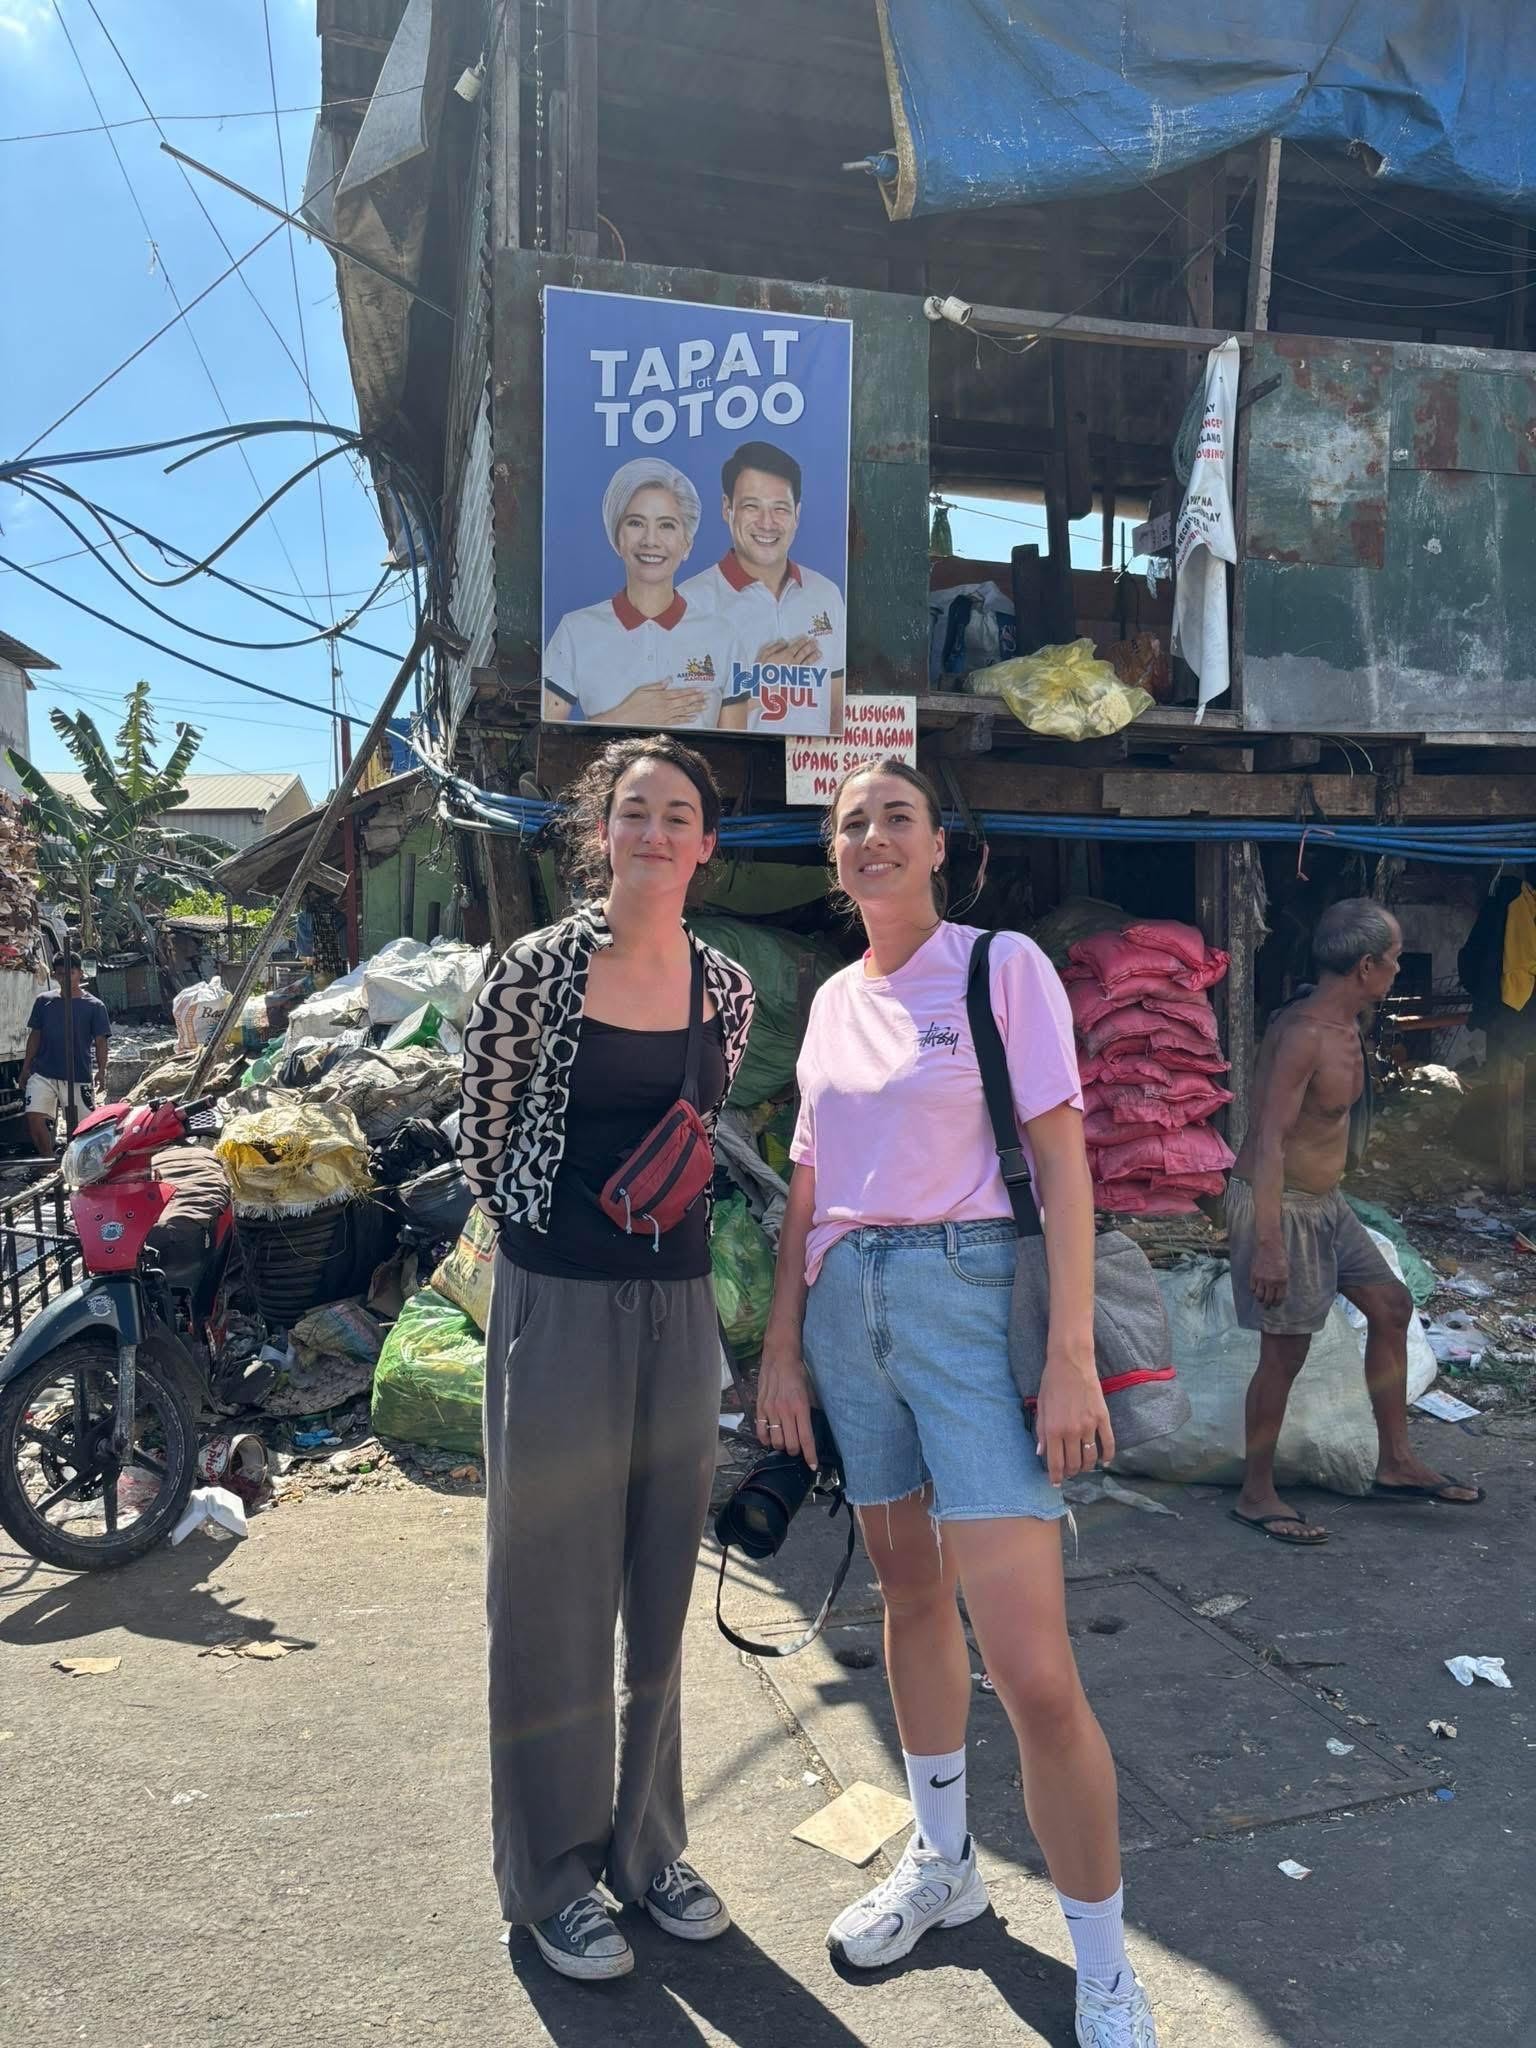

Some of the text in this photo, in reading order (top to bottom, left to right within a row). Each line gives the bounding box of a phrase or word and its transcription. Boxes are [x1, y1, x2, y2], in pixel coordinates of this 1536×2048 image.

[590, 329, 800, 398] TAPAT
[696, 375, 712, 389] at
[594, 381, 805, 447] TOTOO
[732, 662, 828, 697] HONEY
[761, 686, 818, 721] YUL
[845, 704, 905, 722] ALUSUGAN
[792, 751, 838, 772] UPANG
